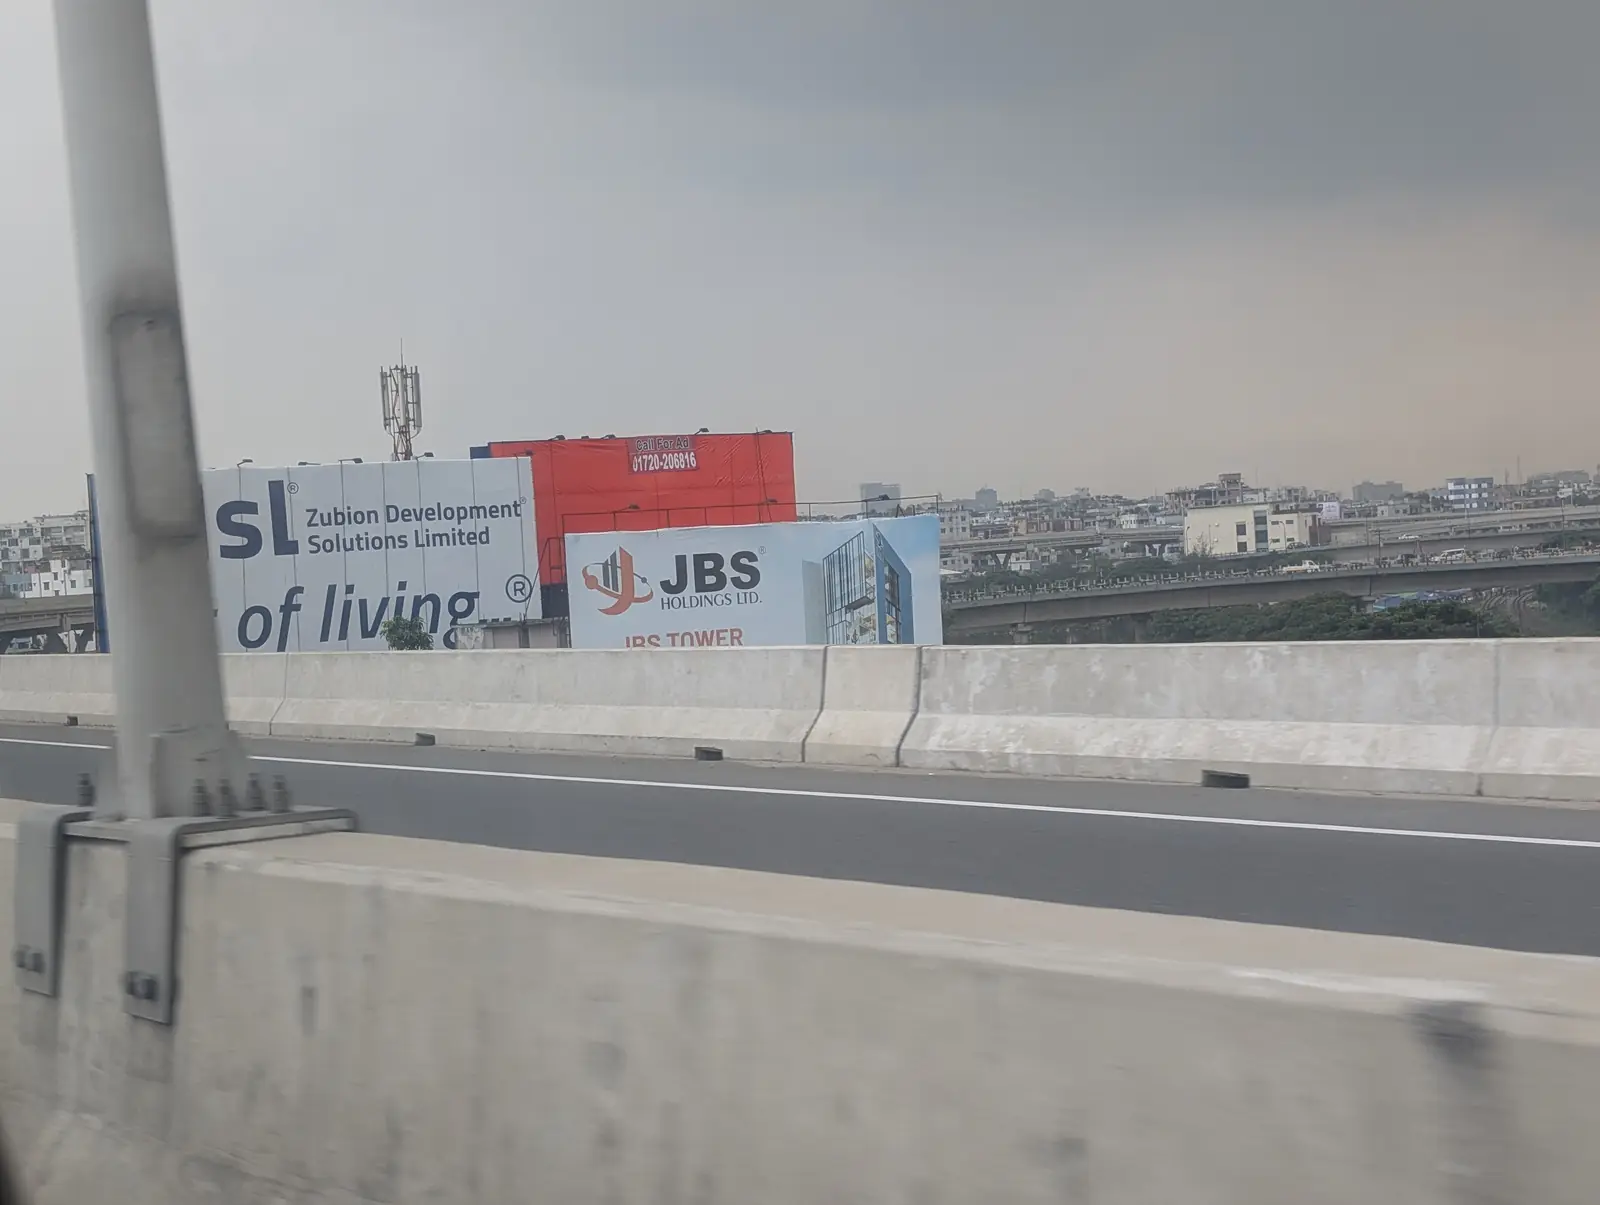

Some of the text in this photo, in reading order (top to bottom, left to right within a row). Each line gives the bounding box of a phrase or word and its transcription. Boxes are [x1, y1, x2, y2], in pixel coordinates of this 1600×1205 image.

[636, 436, 690, 452] Call For Ad
[632, 451, 697, 473] 01720-206816
[305, 500, 522, 527] Zubion Development
[308, 526, 491, 554] Solutions Limited
[659, 551, 761, 595] JBS
[661, 591, 763, 611] HOLDINGS LTD.
[237, 585, 305, 652] of
[319, 580, 480, 650] living
[666, 628, 744, 648] TOWER
